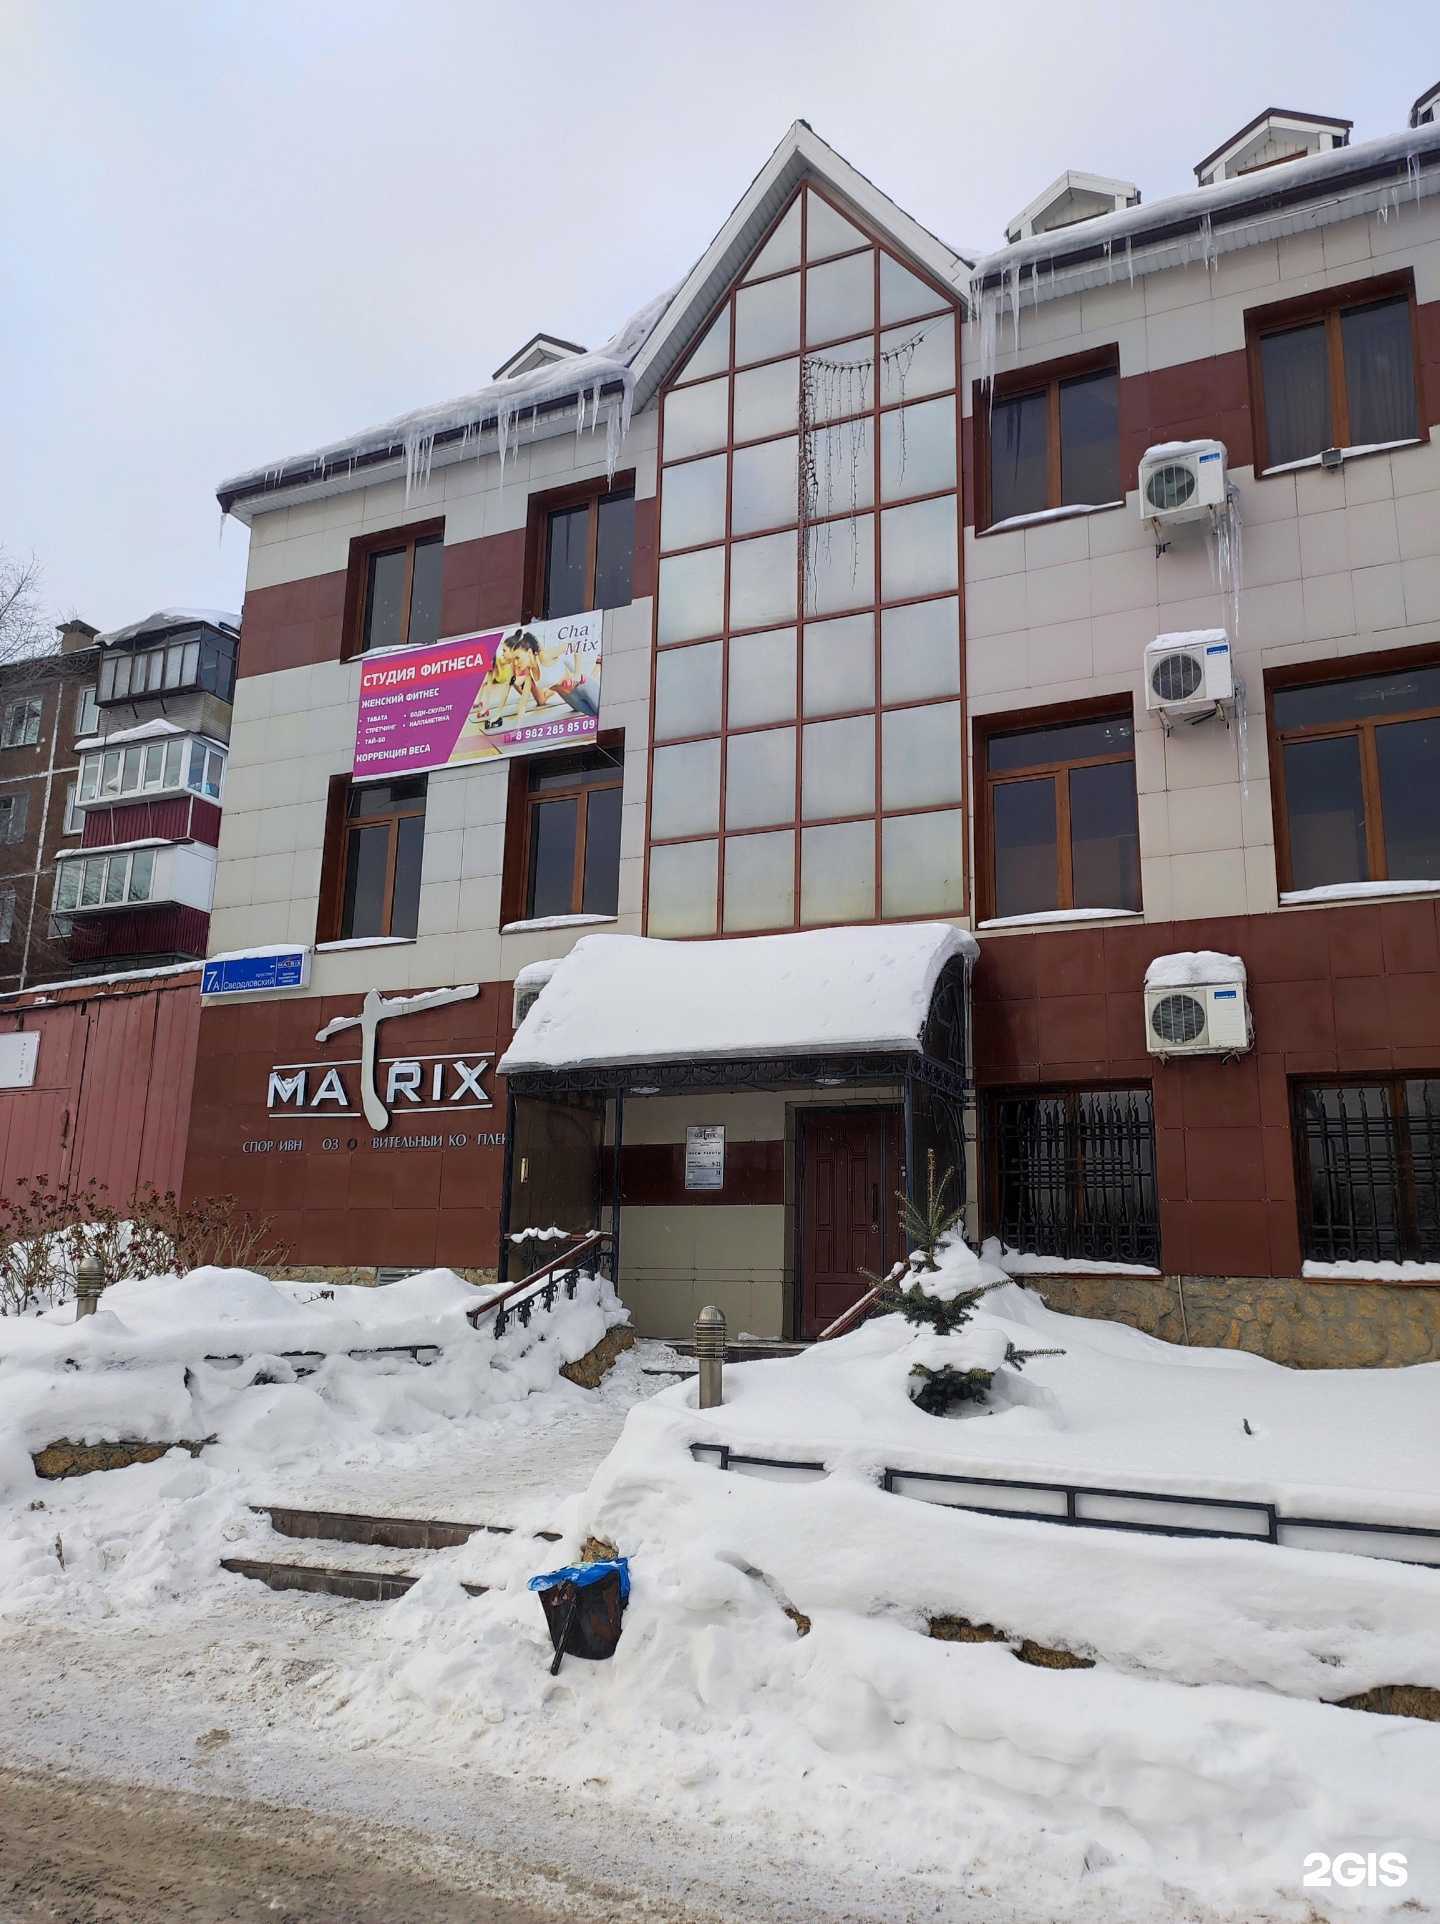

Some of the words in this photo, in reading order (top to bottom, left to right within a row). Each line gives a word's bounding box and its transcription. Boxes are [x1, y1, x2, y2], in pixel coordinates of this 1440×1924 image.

[557, 623, 589, 640] Cha
[565, 639, 599, 656] Mix
[363, 667, 416, 687] СТУДИЯ
[420, 653, 484, 677] ФИТНЕСА
[361, 693, 405, 709] ЖЕНСКИЙ
[405, 687, 441, 702] ФИТНЕС
[515, 730, 523, 741] 8
[525, 727, 544, 739] 982
[546, 723, 565, 736] 285
[567, 721, 580, 732] 85
[582, 719, 596, 730] 09
[356, 747, 408, 763] КОРРЕКЦИЯ
[408, 743, 432, 756] ВЕСА
[223, 977, 275, 991] Свердловский
[266, 984, 489, 1132] MATRIX
